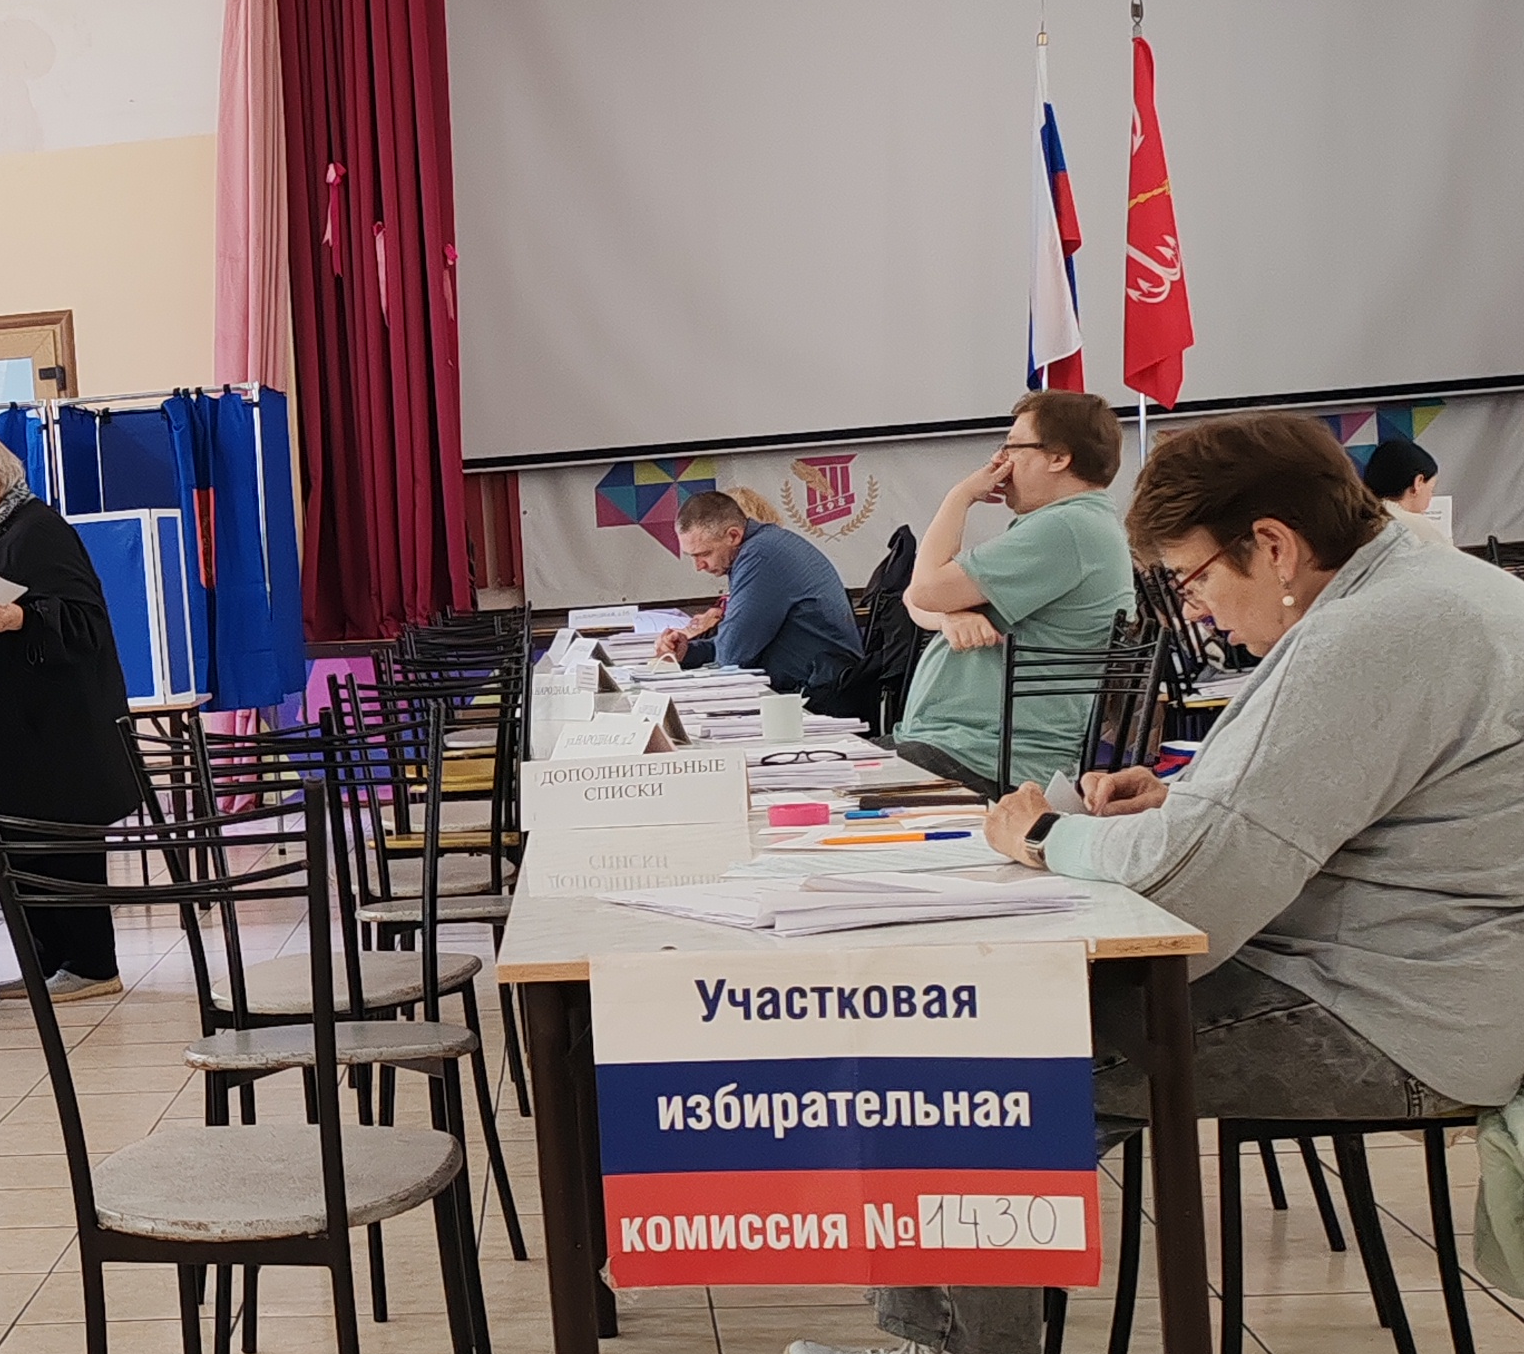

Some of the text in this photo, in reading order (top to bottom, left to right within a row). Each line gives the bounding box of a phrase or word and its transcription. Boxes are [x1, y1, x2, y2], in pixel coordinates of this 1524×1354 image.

[815, 497, 846, 514] 498
[540, 759, 726, 787] ДОПОЛНИТЕЛЬНЫЕ
[584, 783, 664, 801] СПИСКИ
[694, 978, 978, 1022] Участковая
[657, 1083, 1032, 1139] избирательная
[619, 1212, 848, 1253] комиссия
[926, 1195, 1058, 1249] 1430
